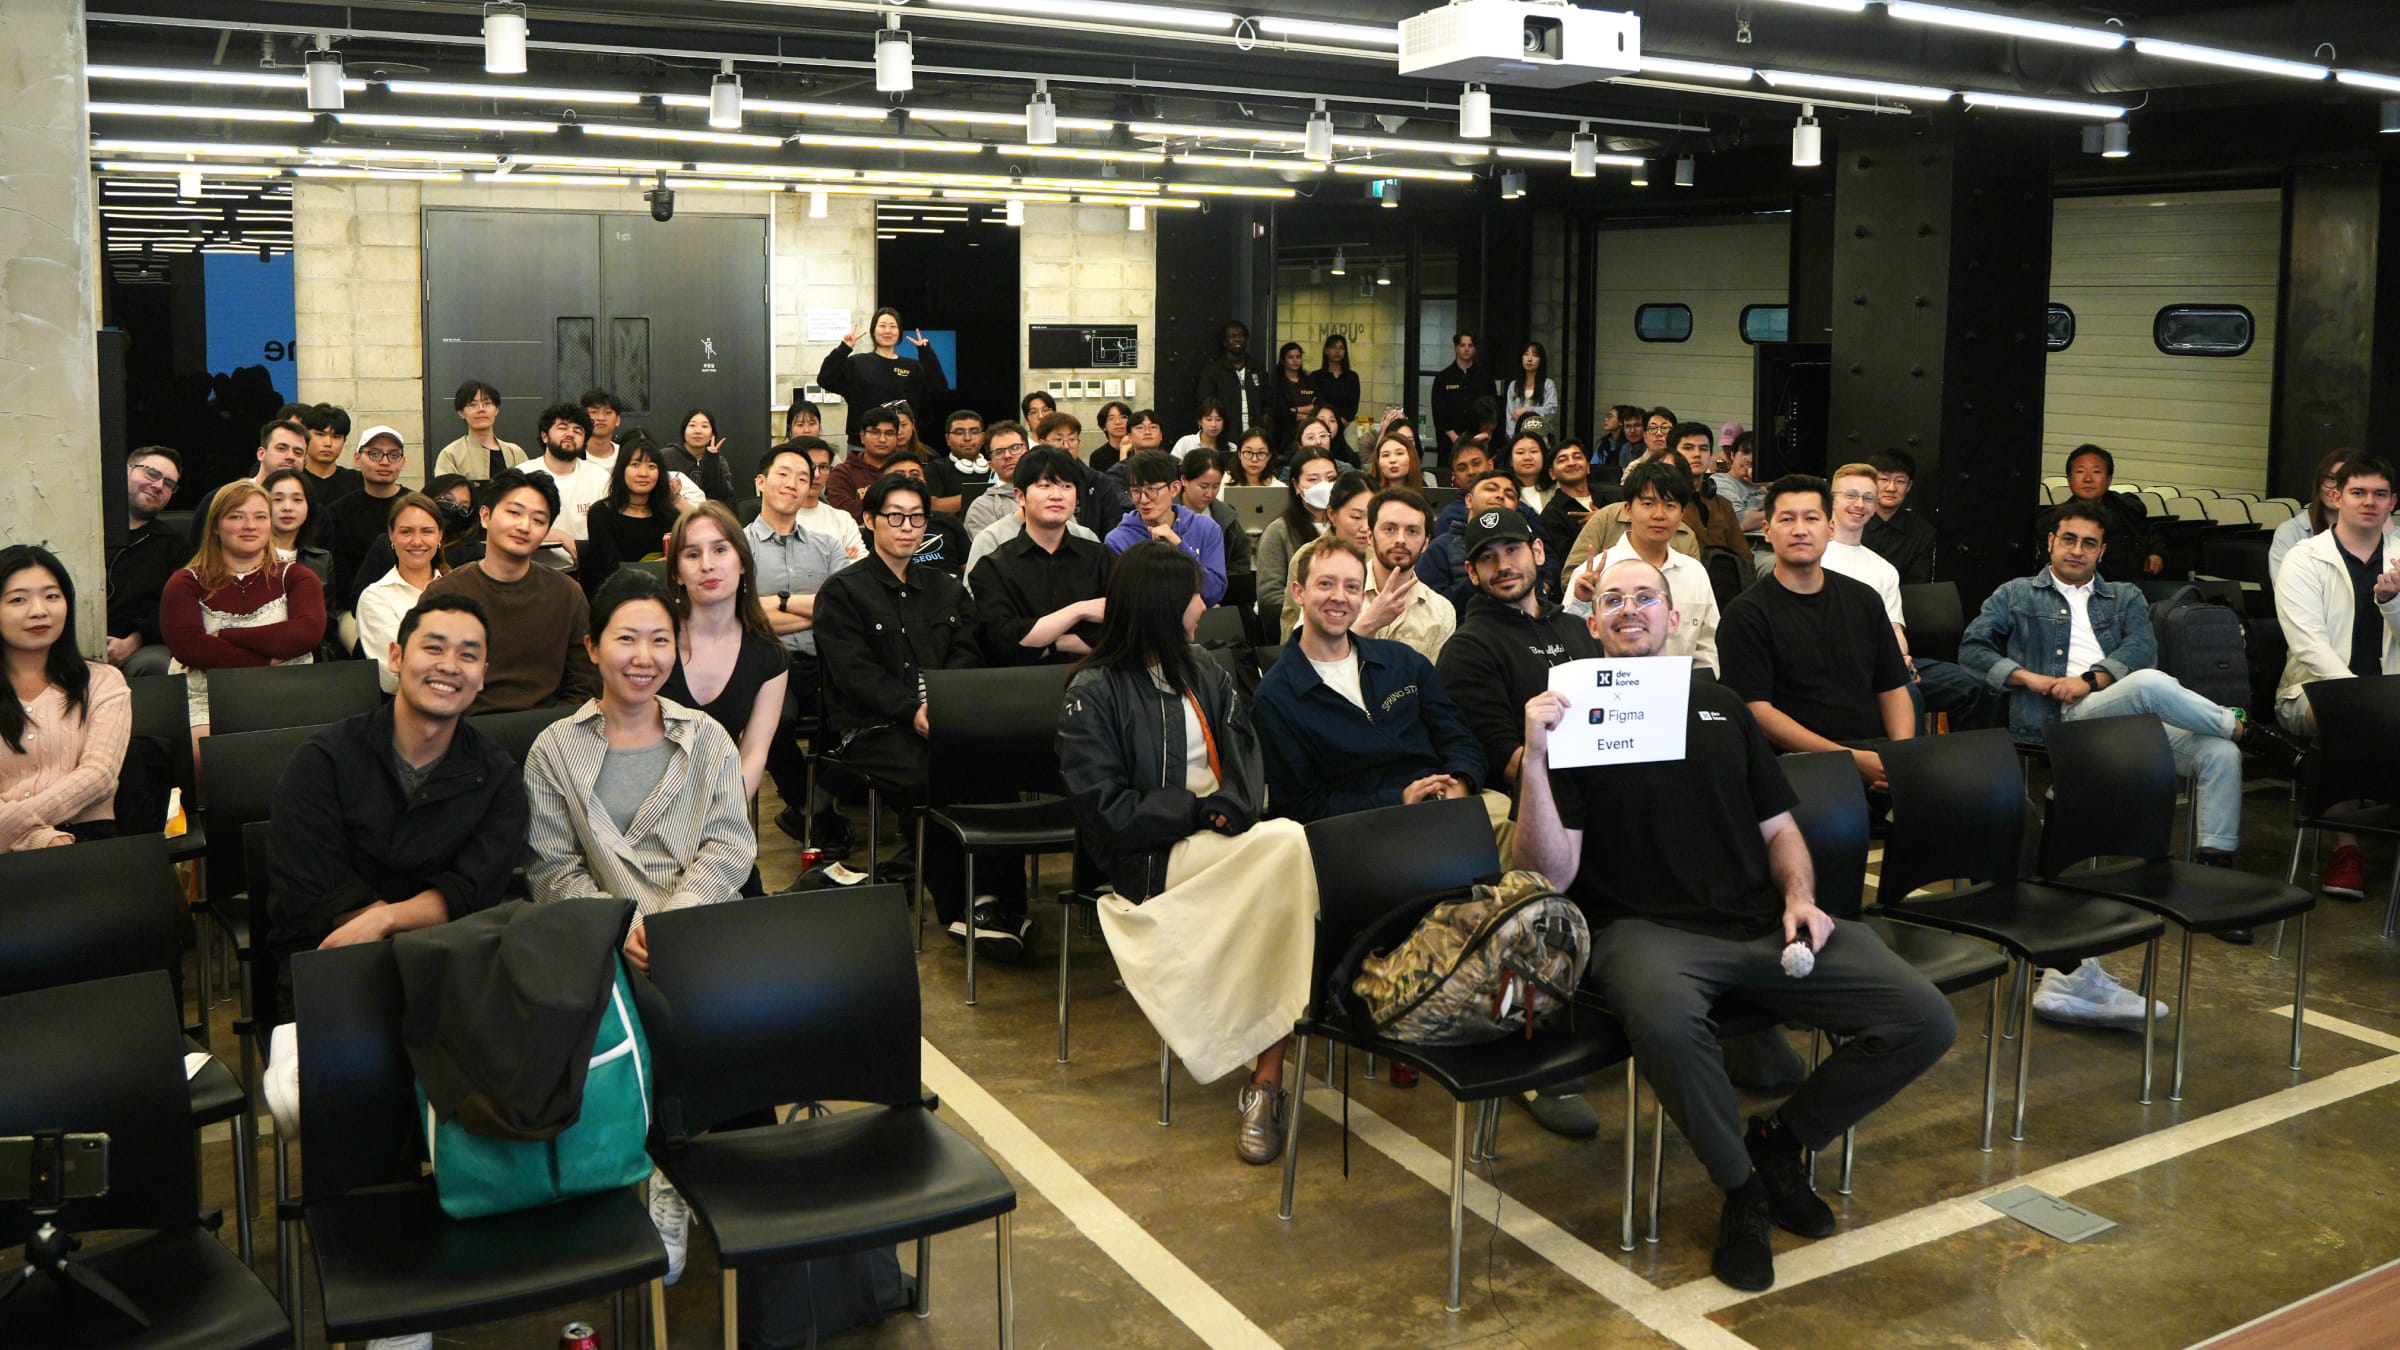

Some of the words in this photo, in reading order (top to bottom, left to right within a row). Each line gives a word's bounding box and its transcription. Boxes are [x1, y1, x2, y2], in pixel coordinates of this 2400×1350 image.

[912, 552, 945, 564] SEOUL
[1616, 669, 1632, 678] dev
[1615, 679, 1640, 687] korea
[1608, 709, 1645, 723] Figma
[1597, 738, 1635, 751] Event
